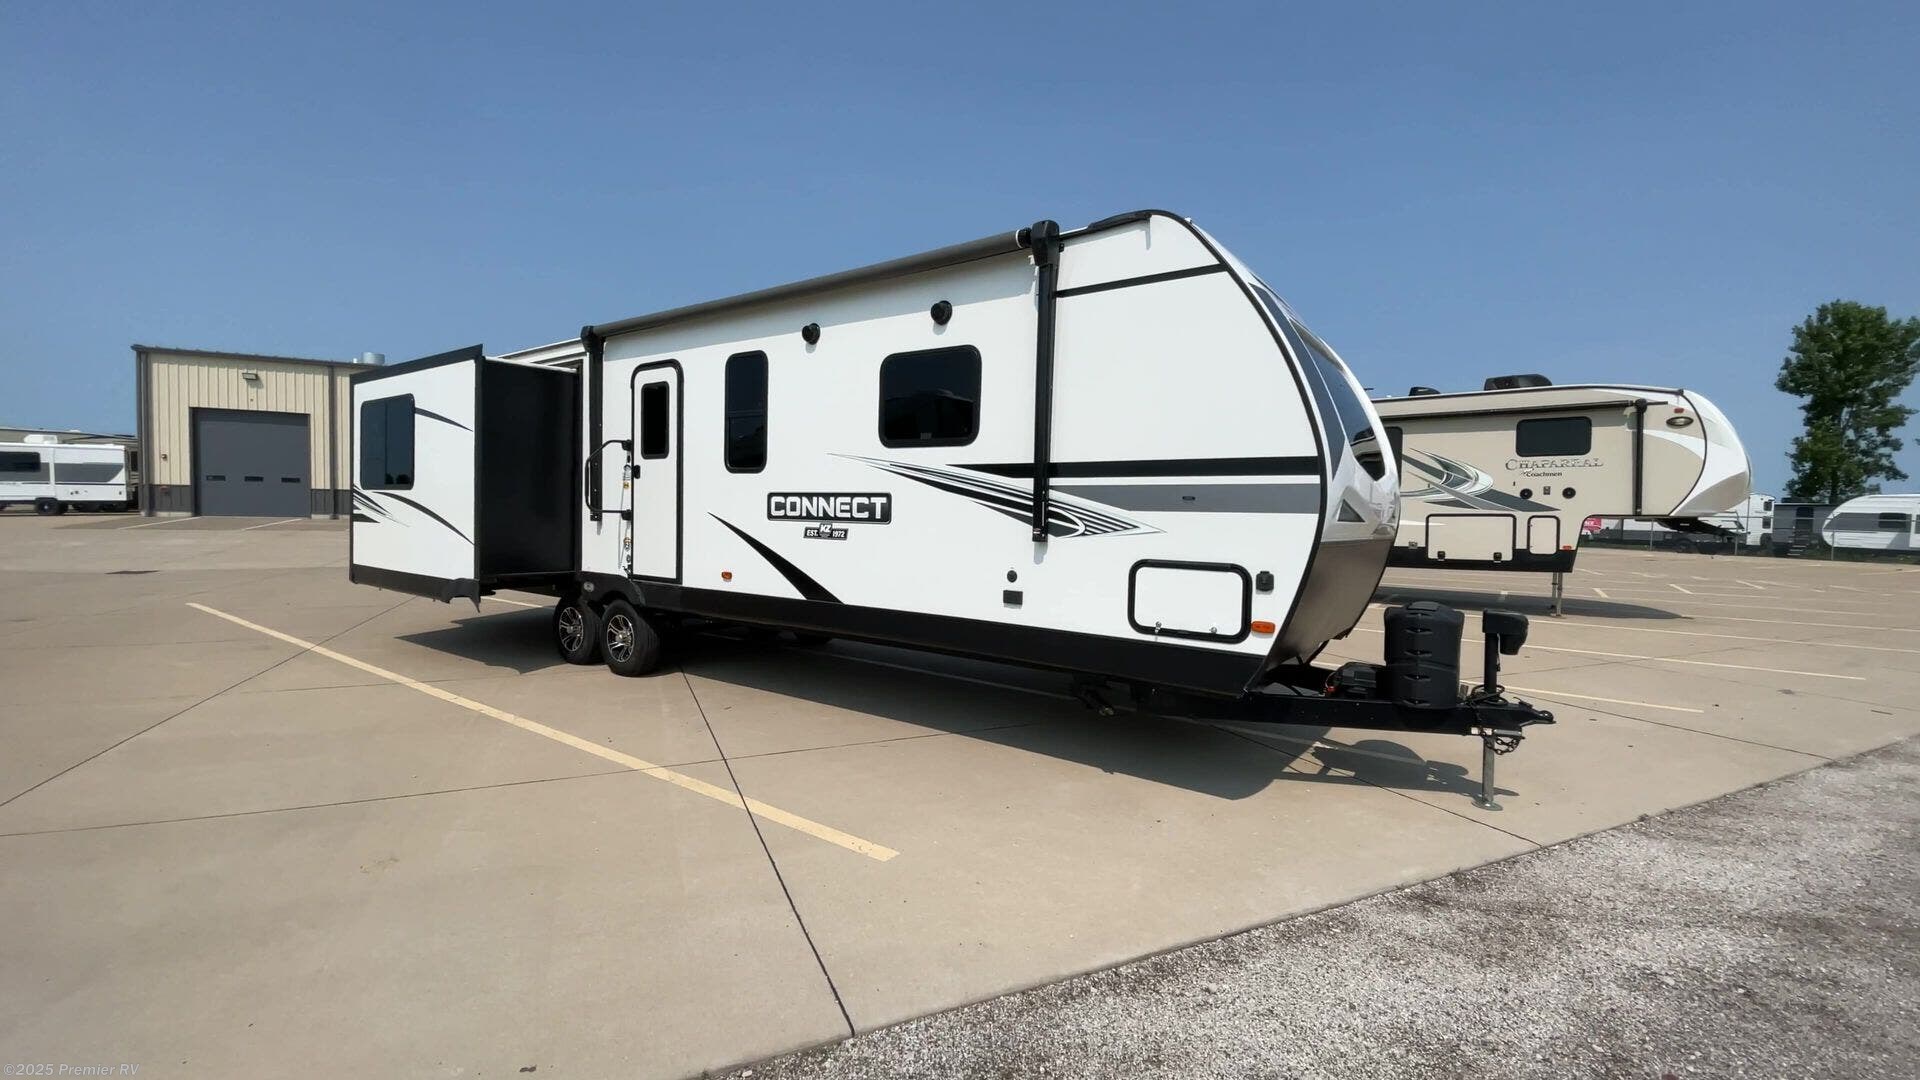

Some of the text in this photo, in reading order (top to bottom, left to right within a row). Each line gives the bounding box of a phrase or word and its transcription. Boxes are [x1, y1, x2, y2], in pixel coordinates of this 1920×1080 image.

[770, 496, 887, 519] CONNECT
[806, 529, 845, 538] EST. 1972
